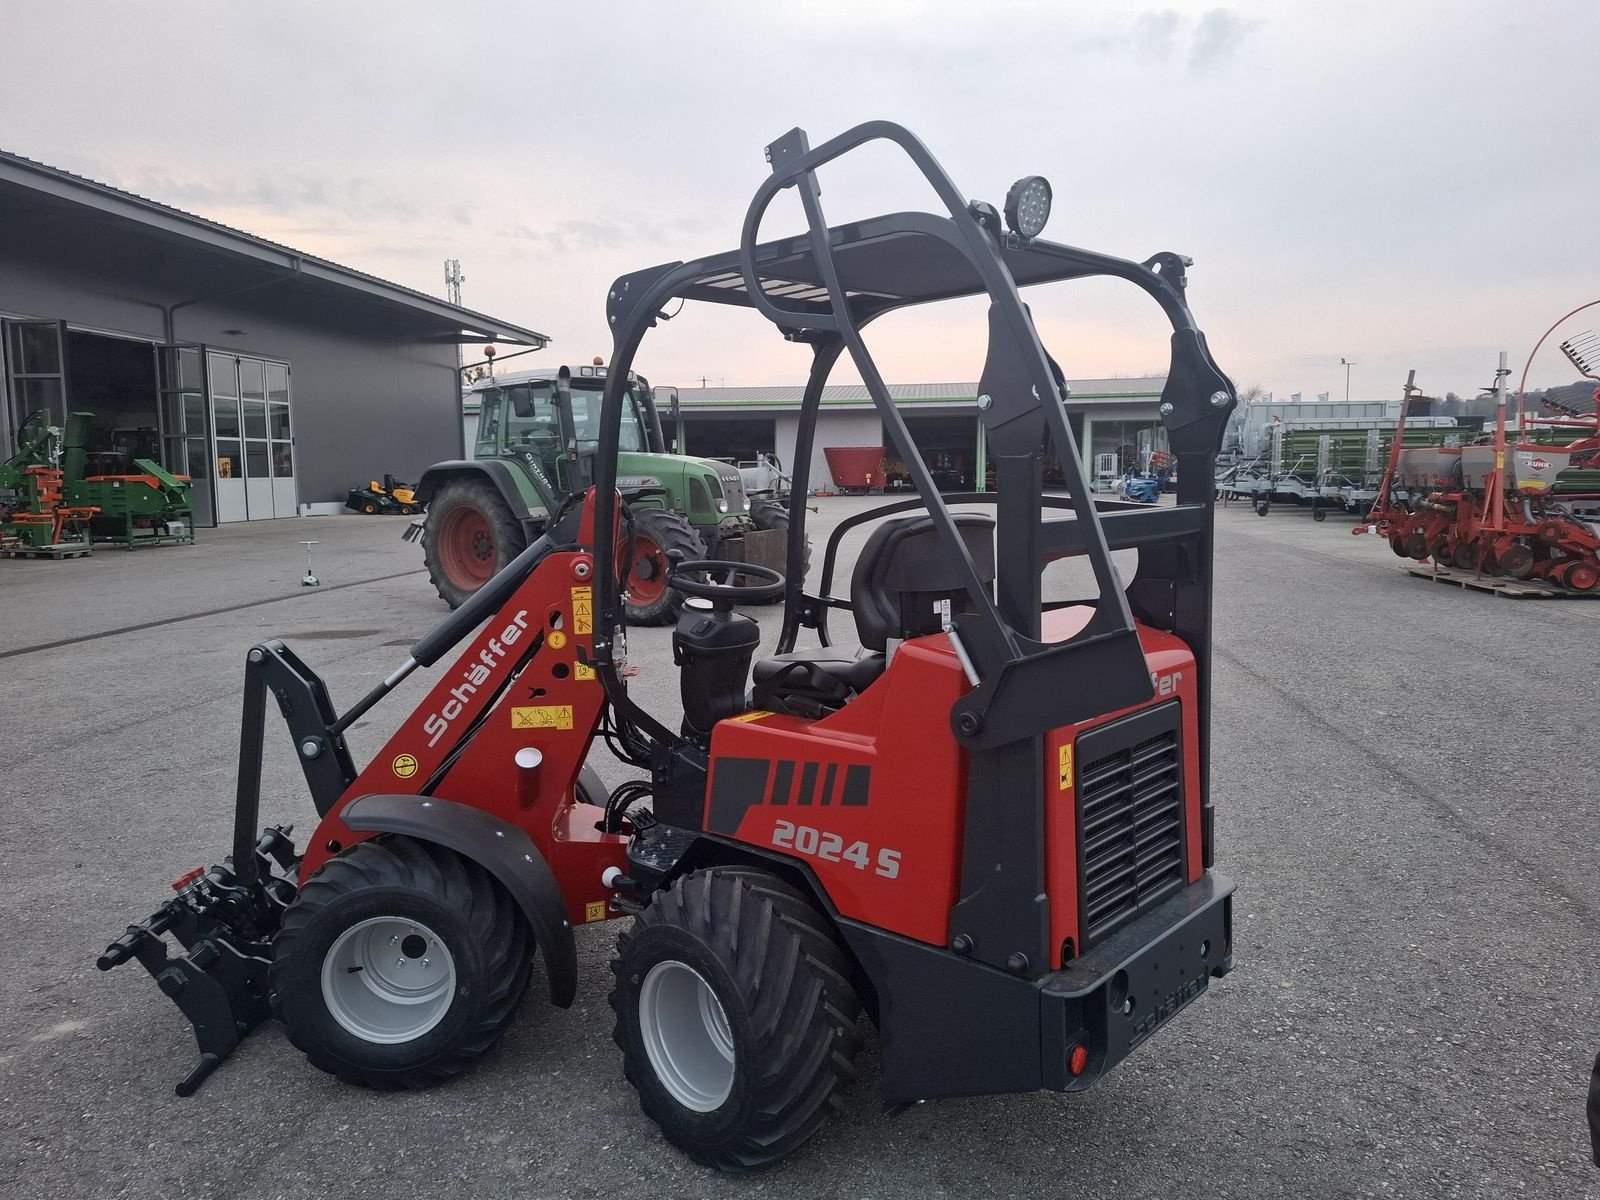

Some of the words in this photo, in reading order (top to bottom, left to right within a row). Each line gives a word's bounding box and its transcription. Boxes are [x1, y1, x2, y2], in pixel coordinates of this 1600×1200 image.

[1527, 461, 1550, 469] KUHN
[423, 609, 529, 748] Schäffer
[772, 818, 870, 870] 2024
[875, 848, 902, 879] S
